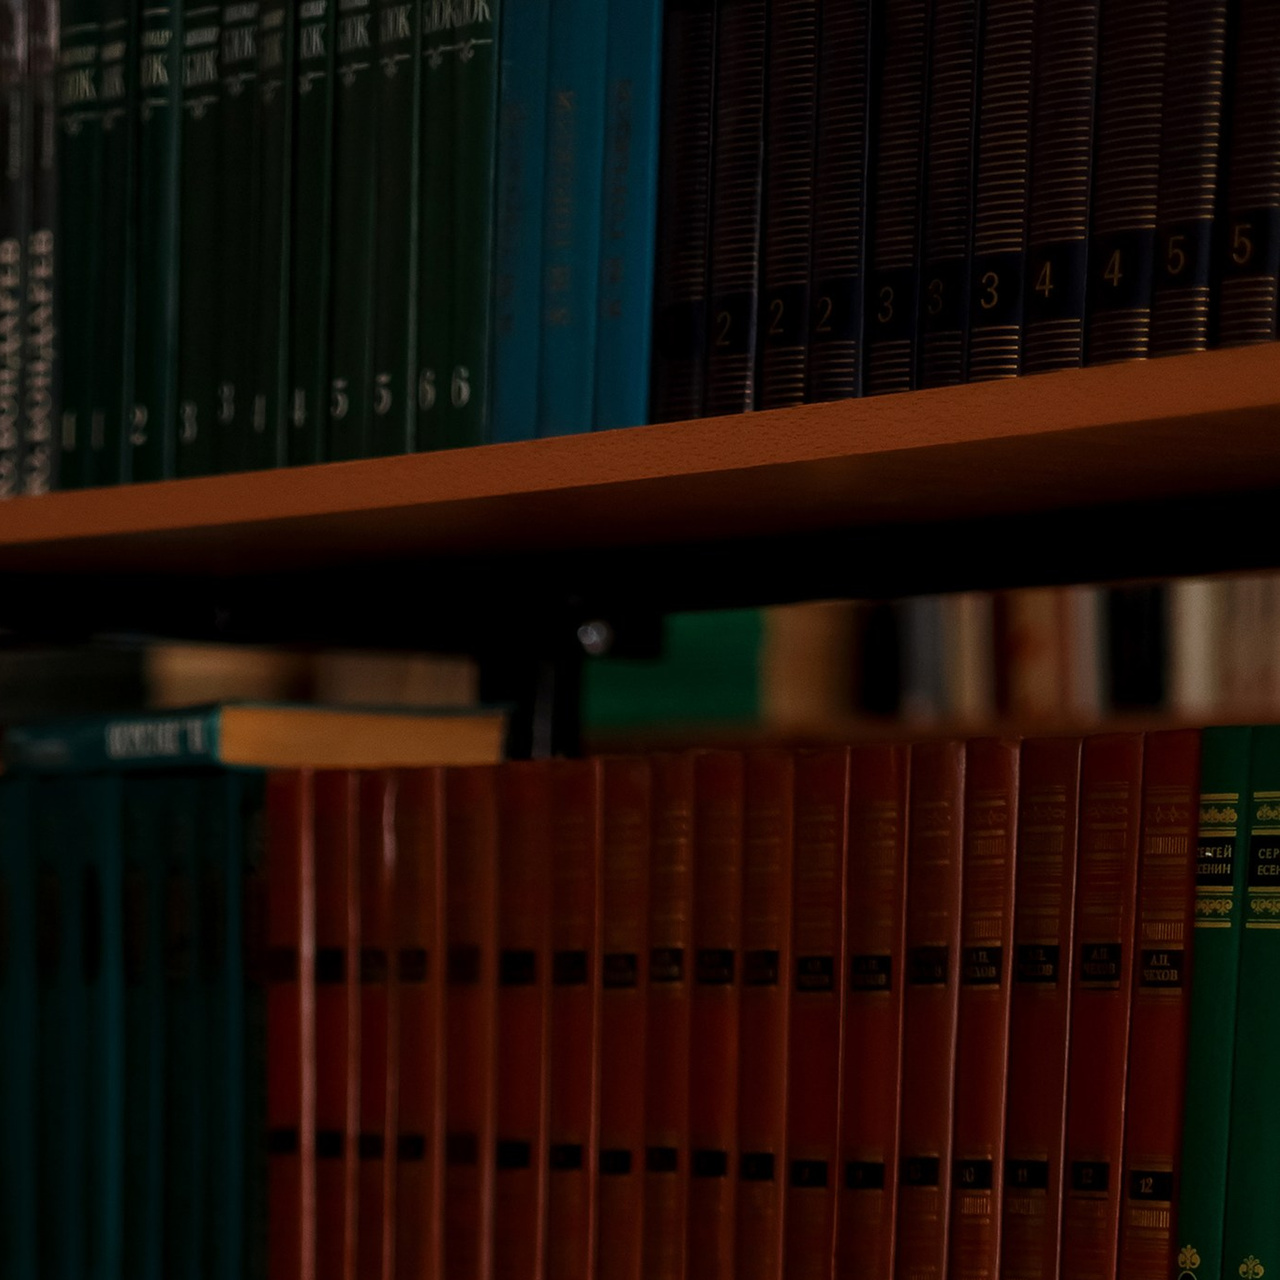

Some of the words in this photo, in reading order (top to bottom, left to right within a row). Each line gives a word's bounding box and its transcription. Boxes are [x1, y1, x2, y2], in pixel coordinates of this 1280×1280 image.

[1166, 235, 1185, 274] 5
[1232, 223, 1253, 264] 5
[1035, 261, 1054, 298] 4
[1104, 249, 1123, 287] 4
[877, 286, 894, 324] 3
[927, 278, 944, 315] 3
[980, 271, 1000, 310] 3
[716, 310, 732, 347] 2
[770, 299, 785, 334] 2
[816, 297, 833, 332] 2
[330, 378, 349, 420] 5
[374, 373, 393, 416] 5
[419, 368, 437, 411] 6
[451, 365, 470, 408] 6
[1197, 844, 1232, 859] ЕРГЕЙ
[1143, 968, 1179, 982] ЧЕХОВ
[1138, 1176, 1154, 1193] 12
